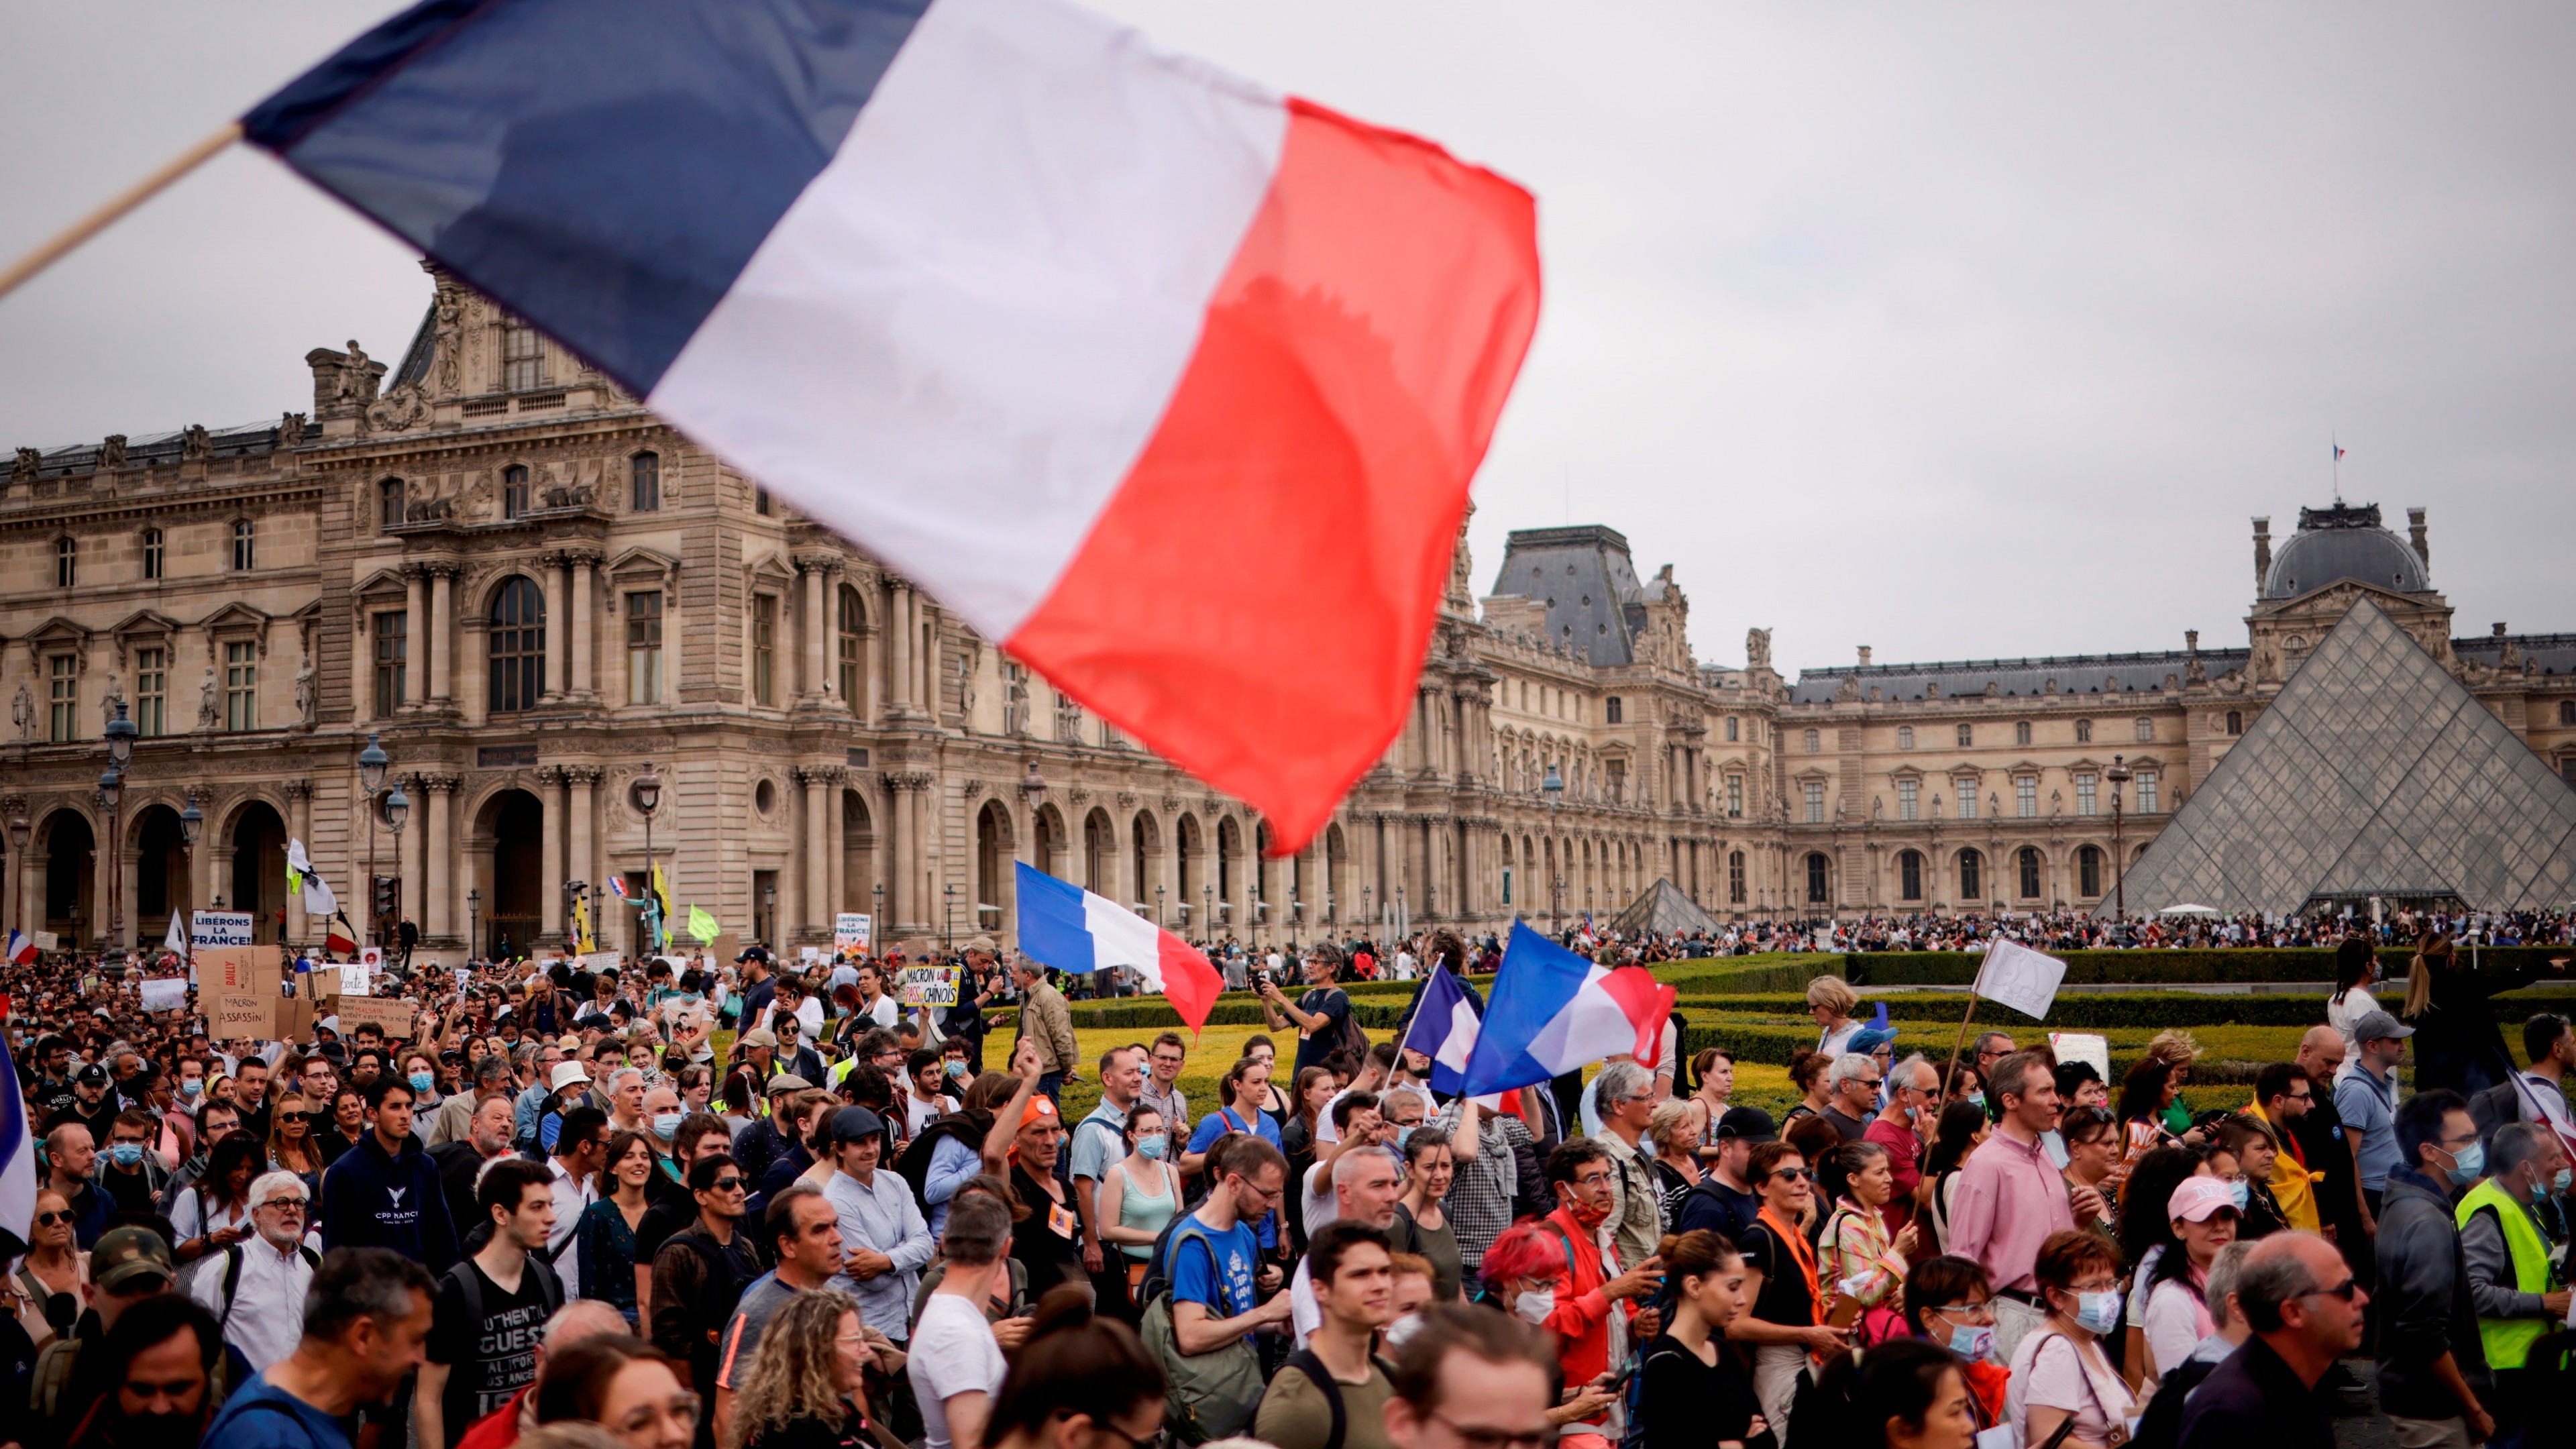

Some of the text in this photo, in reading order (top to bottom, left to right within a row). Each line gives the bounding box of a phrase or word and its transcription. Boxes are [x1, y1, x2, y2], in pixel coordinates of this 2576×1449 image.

[195, 916, 250, 926] LIBÉRONS
[192, 935, 251, 945] FRANCE!
[225, 961, 235, 986] BAILLY
[341, 967, 365, 989] berté
[907, 968, 935, 983] MACRON
[953, 972, 959, 980] LE
[906, 985, 920, 1003] PASS
[225, 998, 258, 1007] MACRON
[51, 1096, 76, 1104] QUALITY
[924, 1114, 941, 1125] NIK
[2131, 1123, 2157, 1147] NO
[2192, 1183, 2226, 1201] NY
[484, 1303, 547, 1332] UTHENTIC
[487, 1354, 535, 1374] ALIFOR
[486, 1375, 504, 1387] OS
